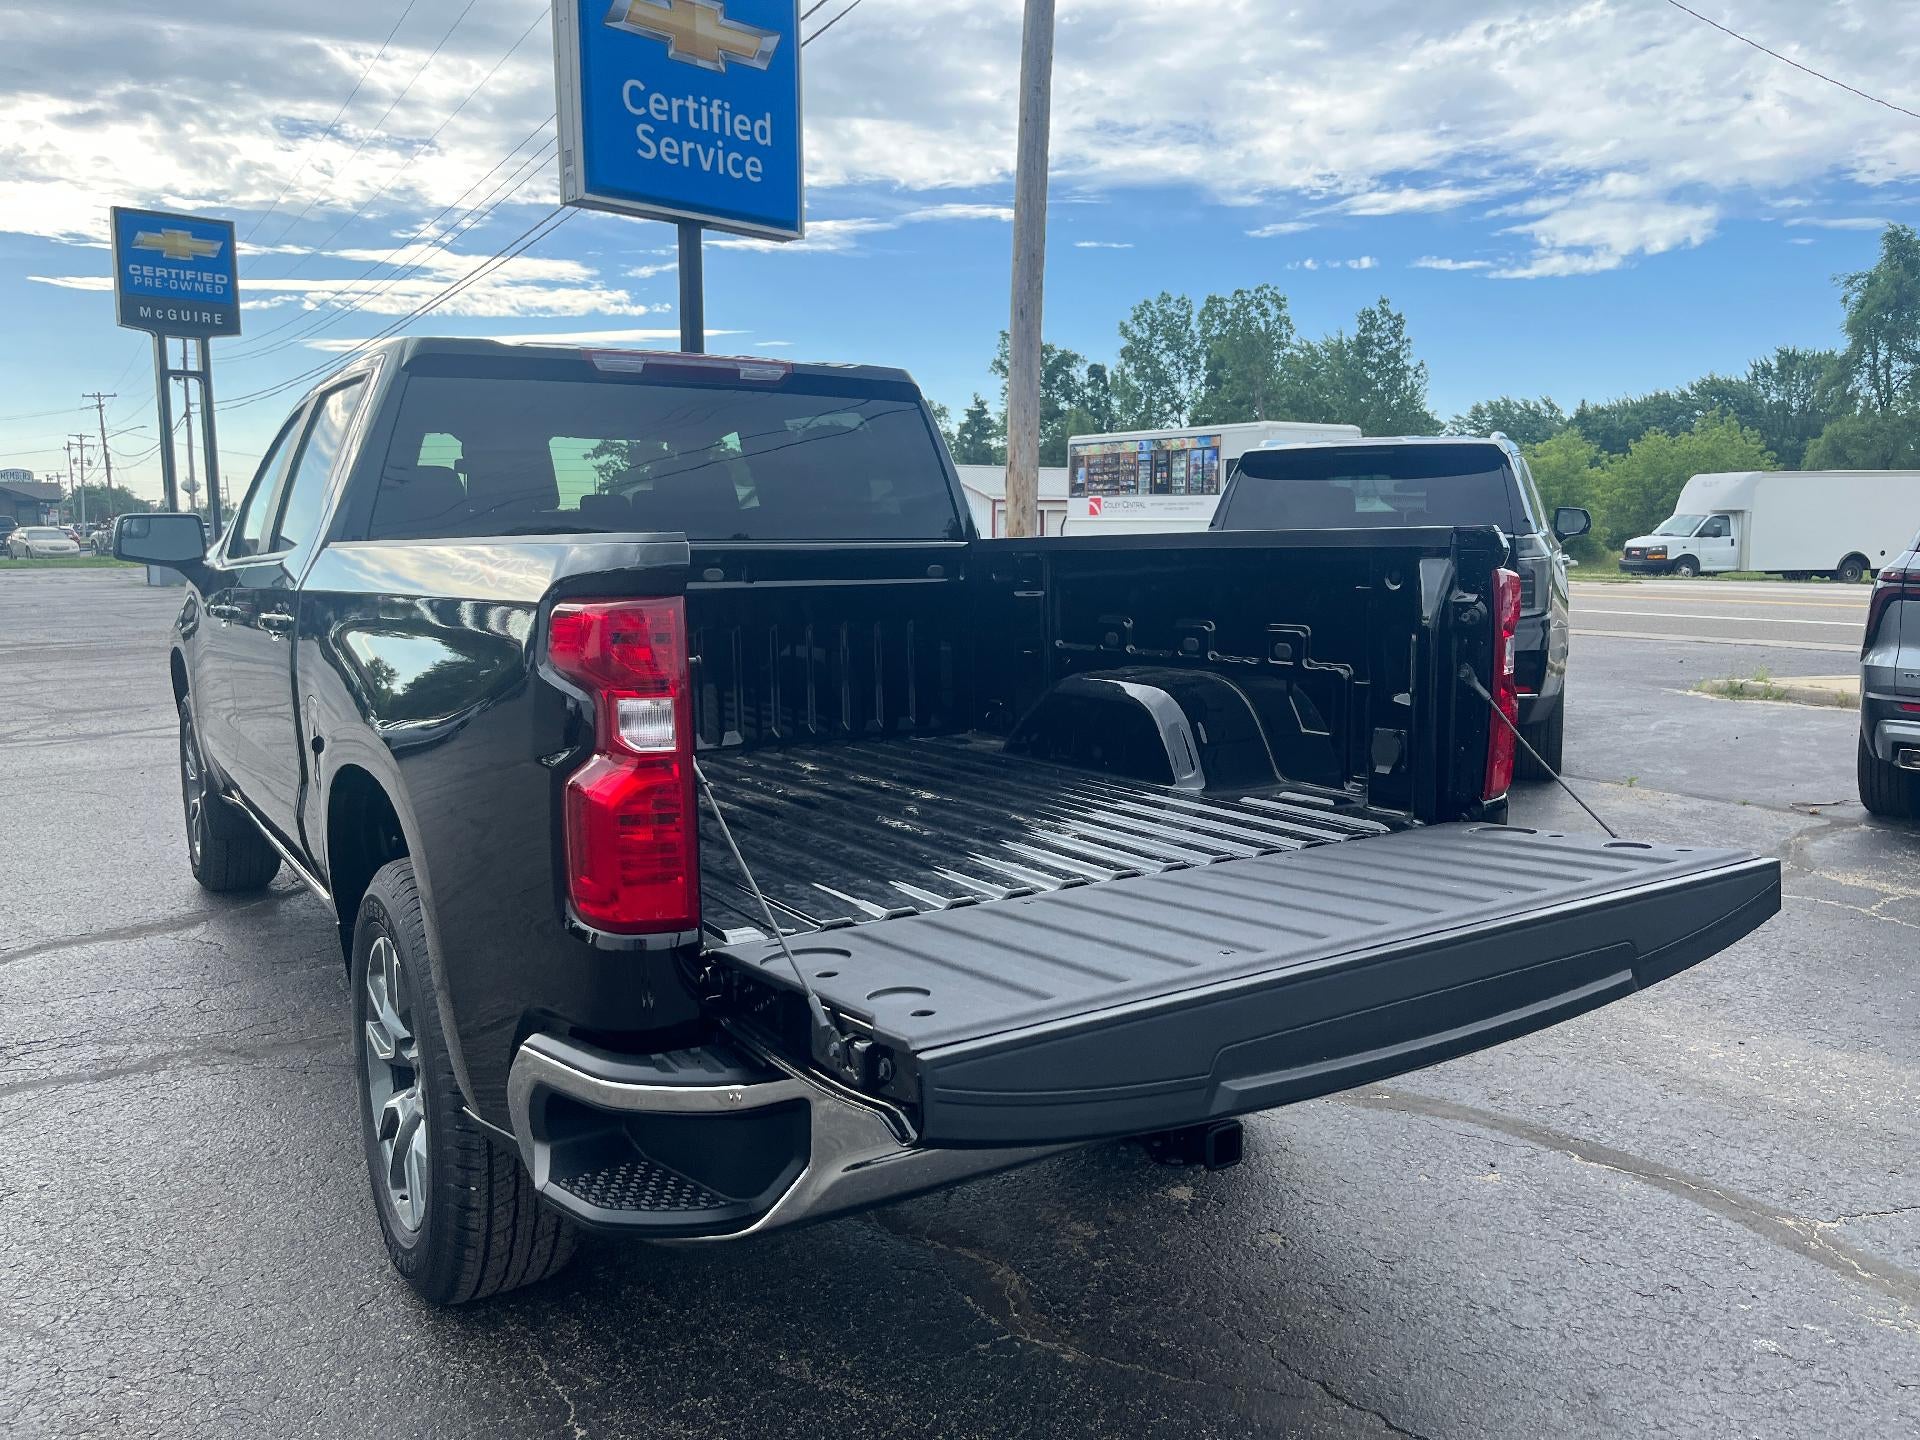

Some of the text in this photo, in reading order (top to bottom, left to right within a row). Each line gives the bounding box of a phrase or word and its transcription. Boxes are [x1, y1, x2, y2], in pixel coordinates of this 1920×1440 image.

[622, 79, 772, 146] Certified
[635, 123, 763, 182] Service
[128, 264, 228, 284] CERTIFIED
[134, 276, 224, 294] PRE-OWNED
[139, 306, 223, 325] McGUIRE
